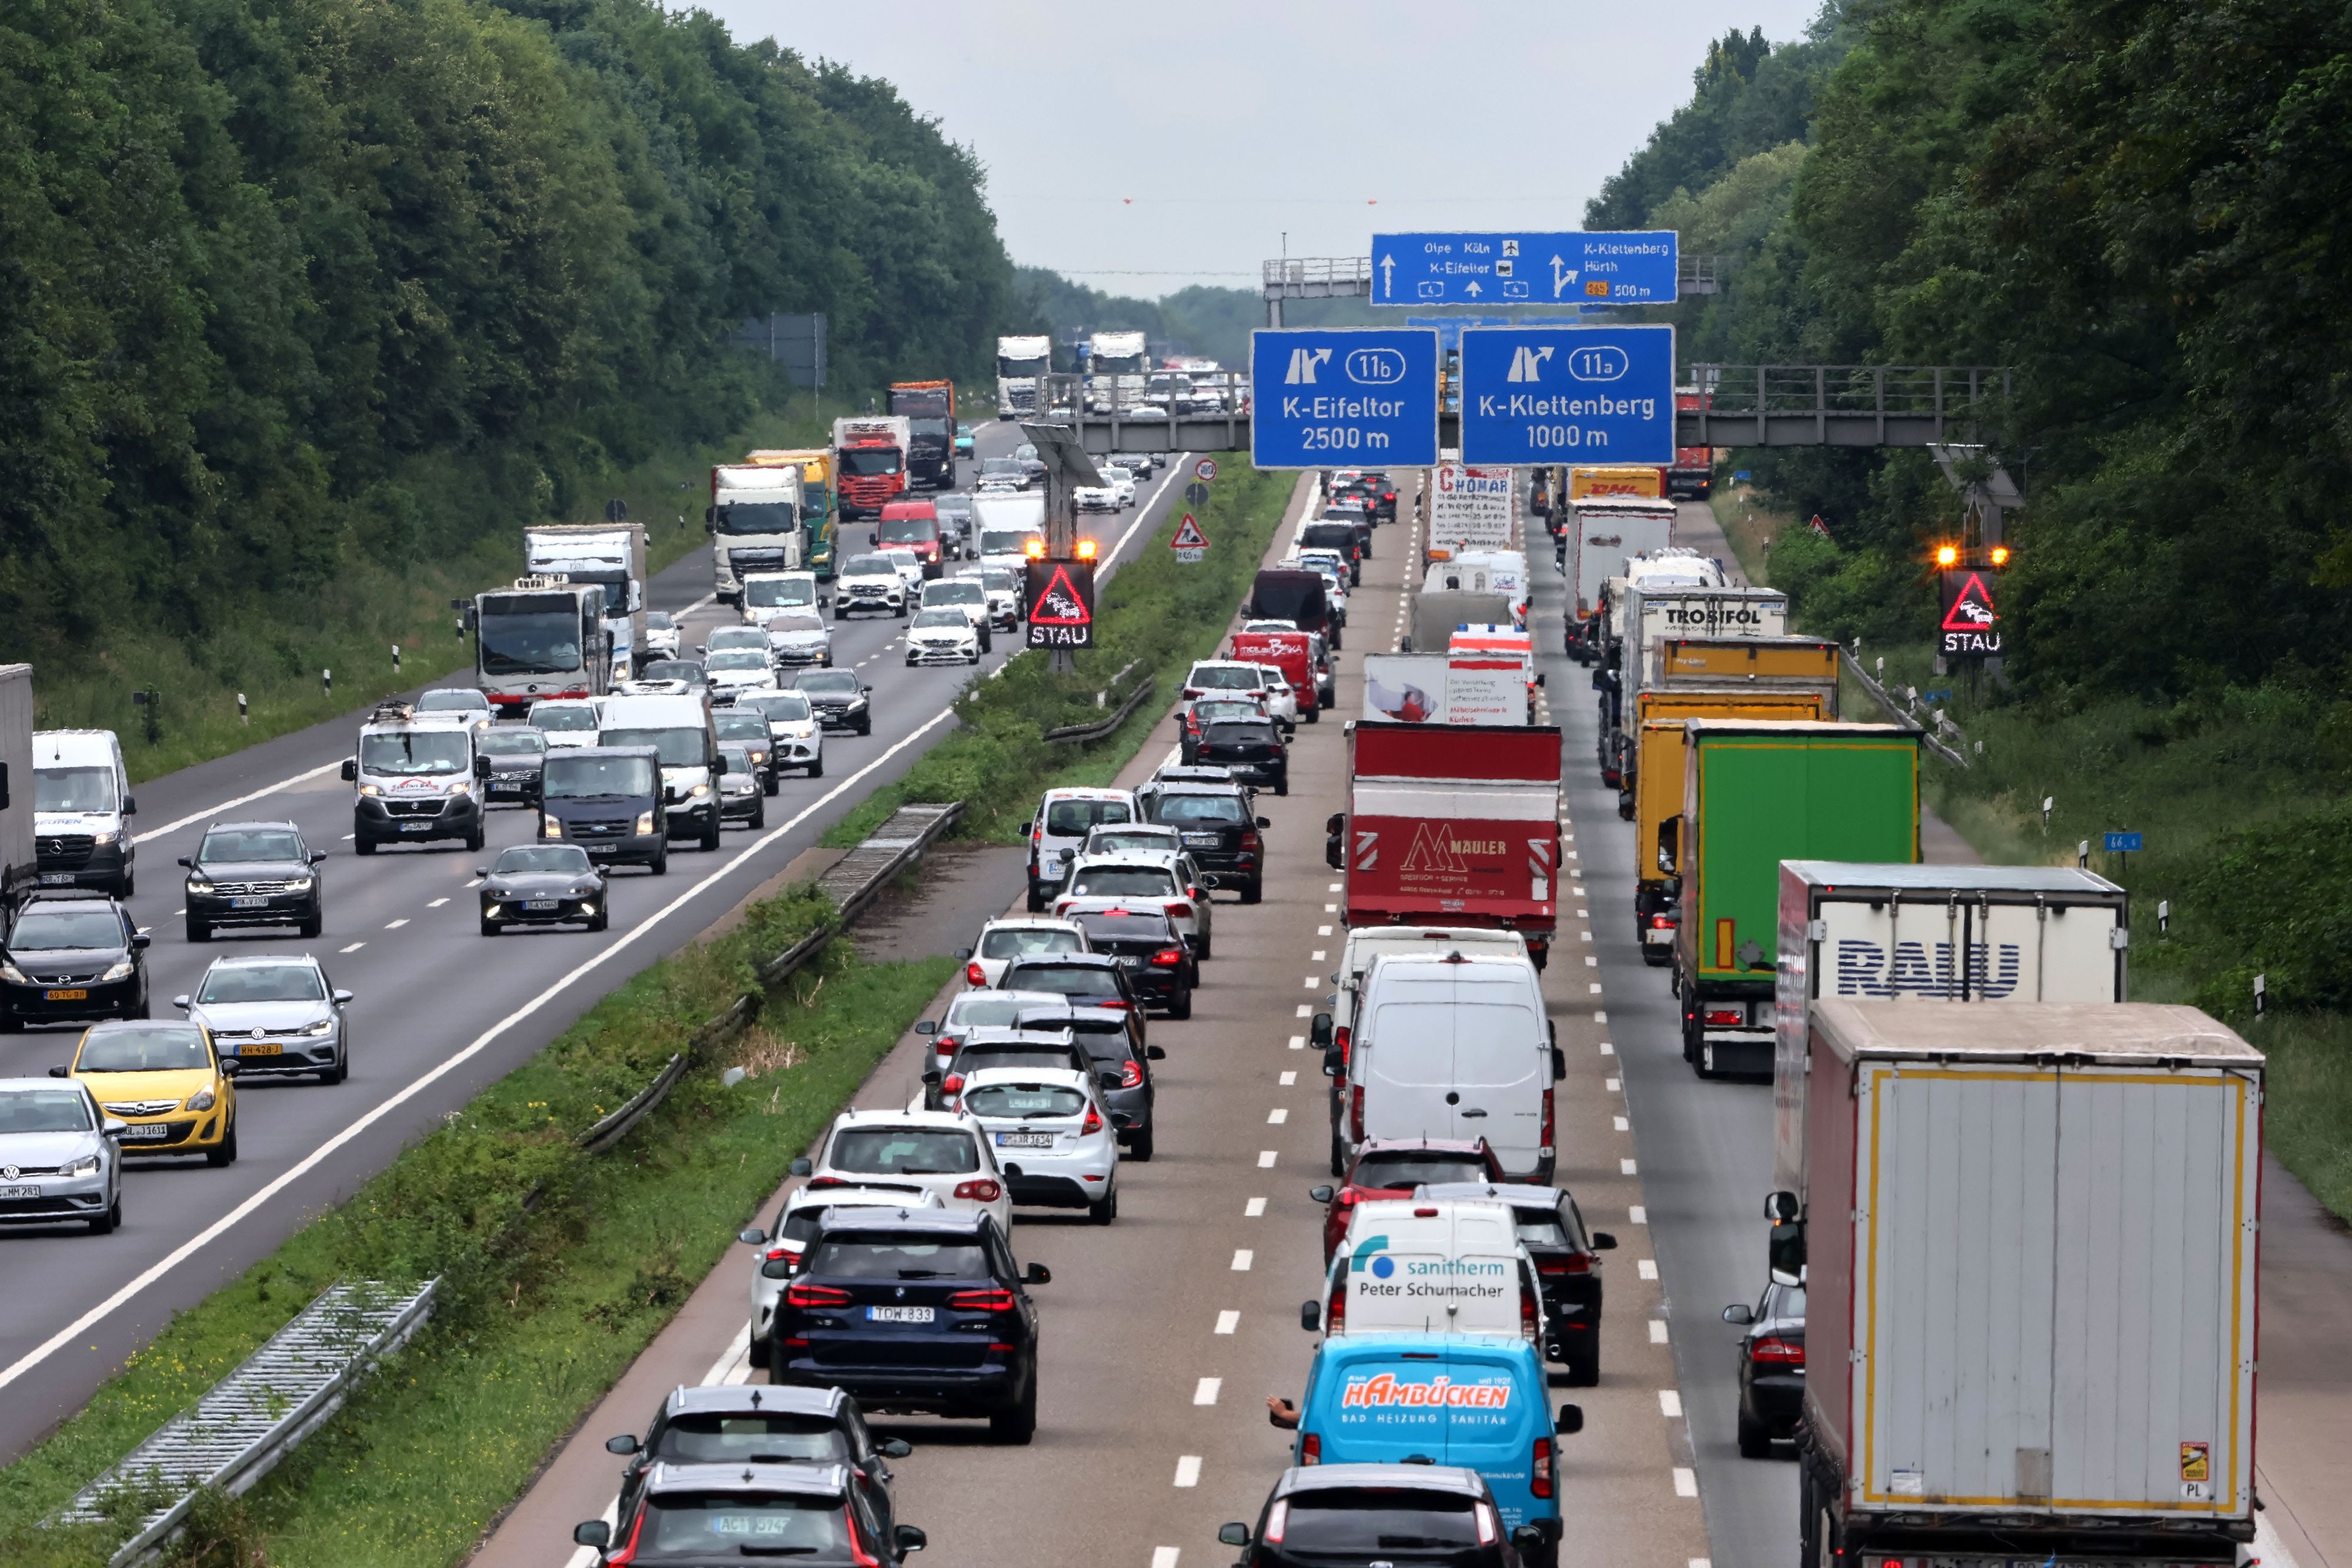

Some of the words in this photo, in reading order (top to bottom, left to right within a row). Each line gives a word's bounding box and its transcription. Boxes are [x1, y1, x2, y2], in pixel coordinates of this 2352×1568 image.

[1424, 242, 1452, 255] Olpe
[1464, 242, 1490, 253] Köln
[1584, 242, 1668, 256] K-Klettenberg
[1430, 262, 1489, 274] K-Eifeltor
[1585, 260, 1618, 272] Hürth
[1428, 285, 1434, 295] 4
[1512, 285, 1518, 294] 4
[1588, 284, 1605, 293] 265
[1615, 285, 1636, 296] 500
[1639, 287, 1650, 296] m
[1359, 355, 1391, 377] 11b
[1583, 353, 1612, 374] 11a
[1283, 396, 1405, 419] K-Eifeltor
[1479, 394, 1655, 420] K-Klettenberg
[1302, 427, 1360, 450] 2500
[1367, 432, 1389, 448] m
[1527, 425, 1580, 447] 1000
[1587, 430, 1608, 446] m
[1590, 483, 1639, 495] DHL
[1666, 609, 1761, 624] TROSIFOL
[1031, 626, 1088, 644] STAU
[1945, 633, 2000, 651] STAU
[1838, 940, 2019, 998] RALU
[22, 1186, 39, 1196] 281
[1408, 1259, 1505, 1276] sanitherm
[1360, 1282, 1402, 1296] Peter
[1407, 1282, 1504, 1298] Schumacher
[1342, 1372, 1511, 1409] HAMBÜCKEN
[1342, 1414, 1367, 1423] BAD
[1377, 1414, 1437, 1423] HEIZUNG
[1451, 1415, 1507, 1425] SANITÄR
[2187, 1483, 2201, 1497] PL
